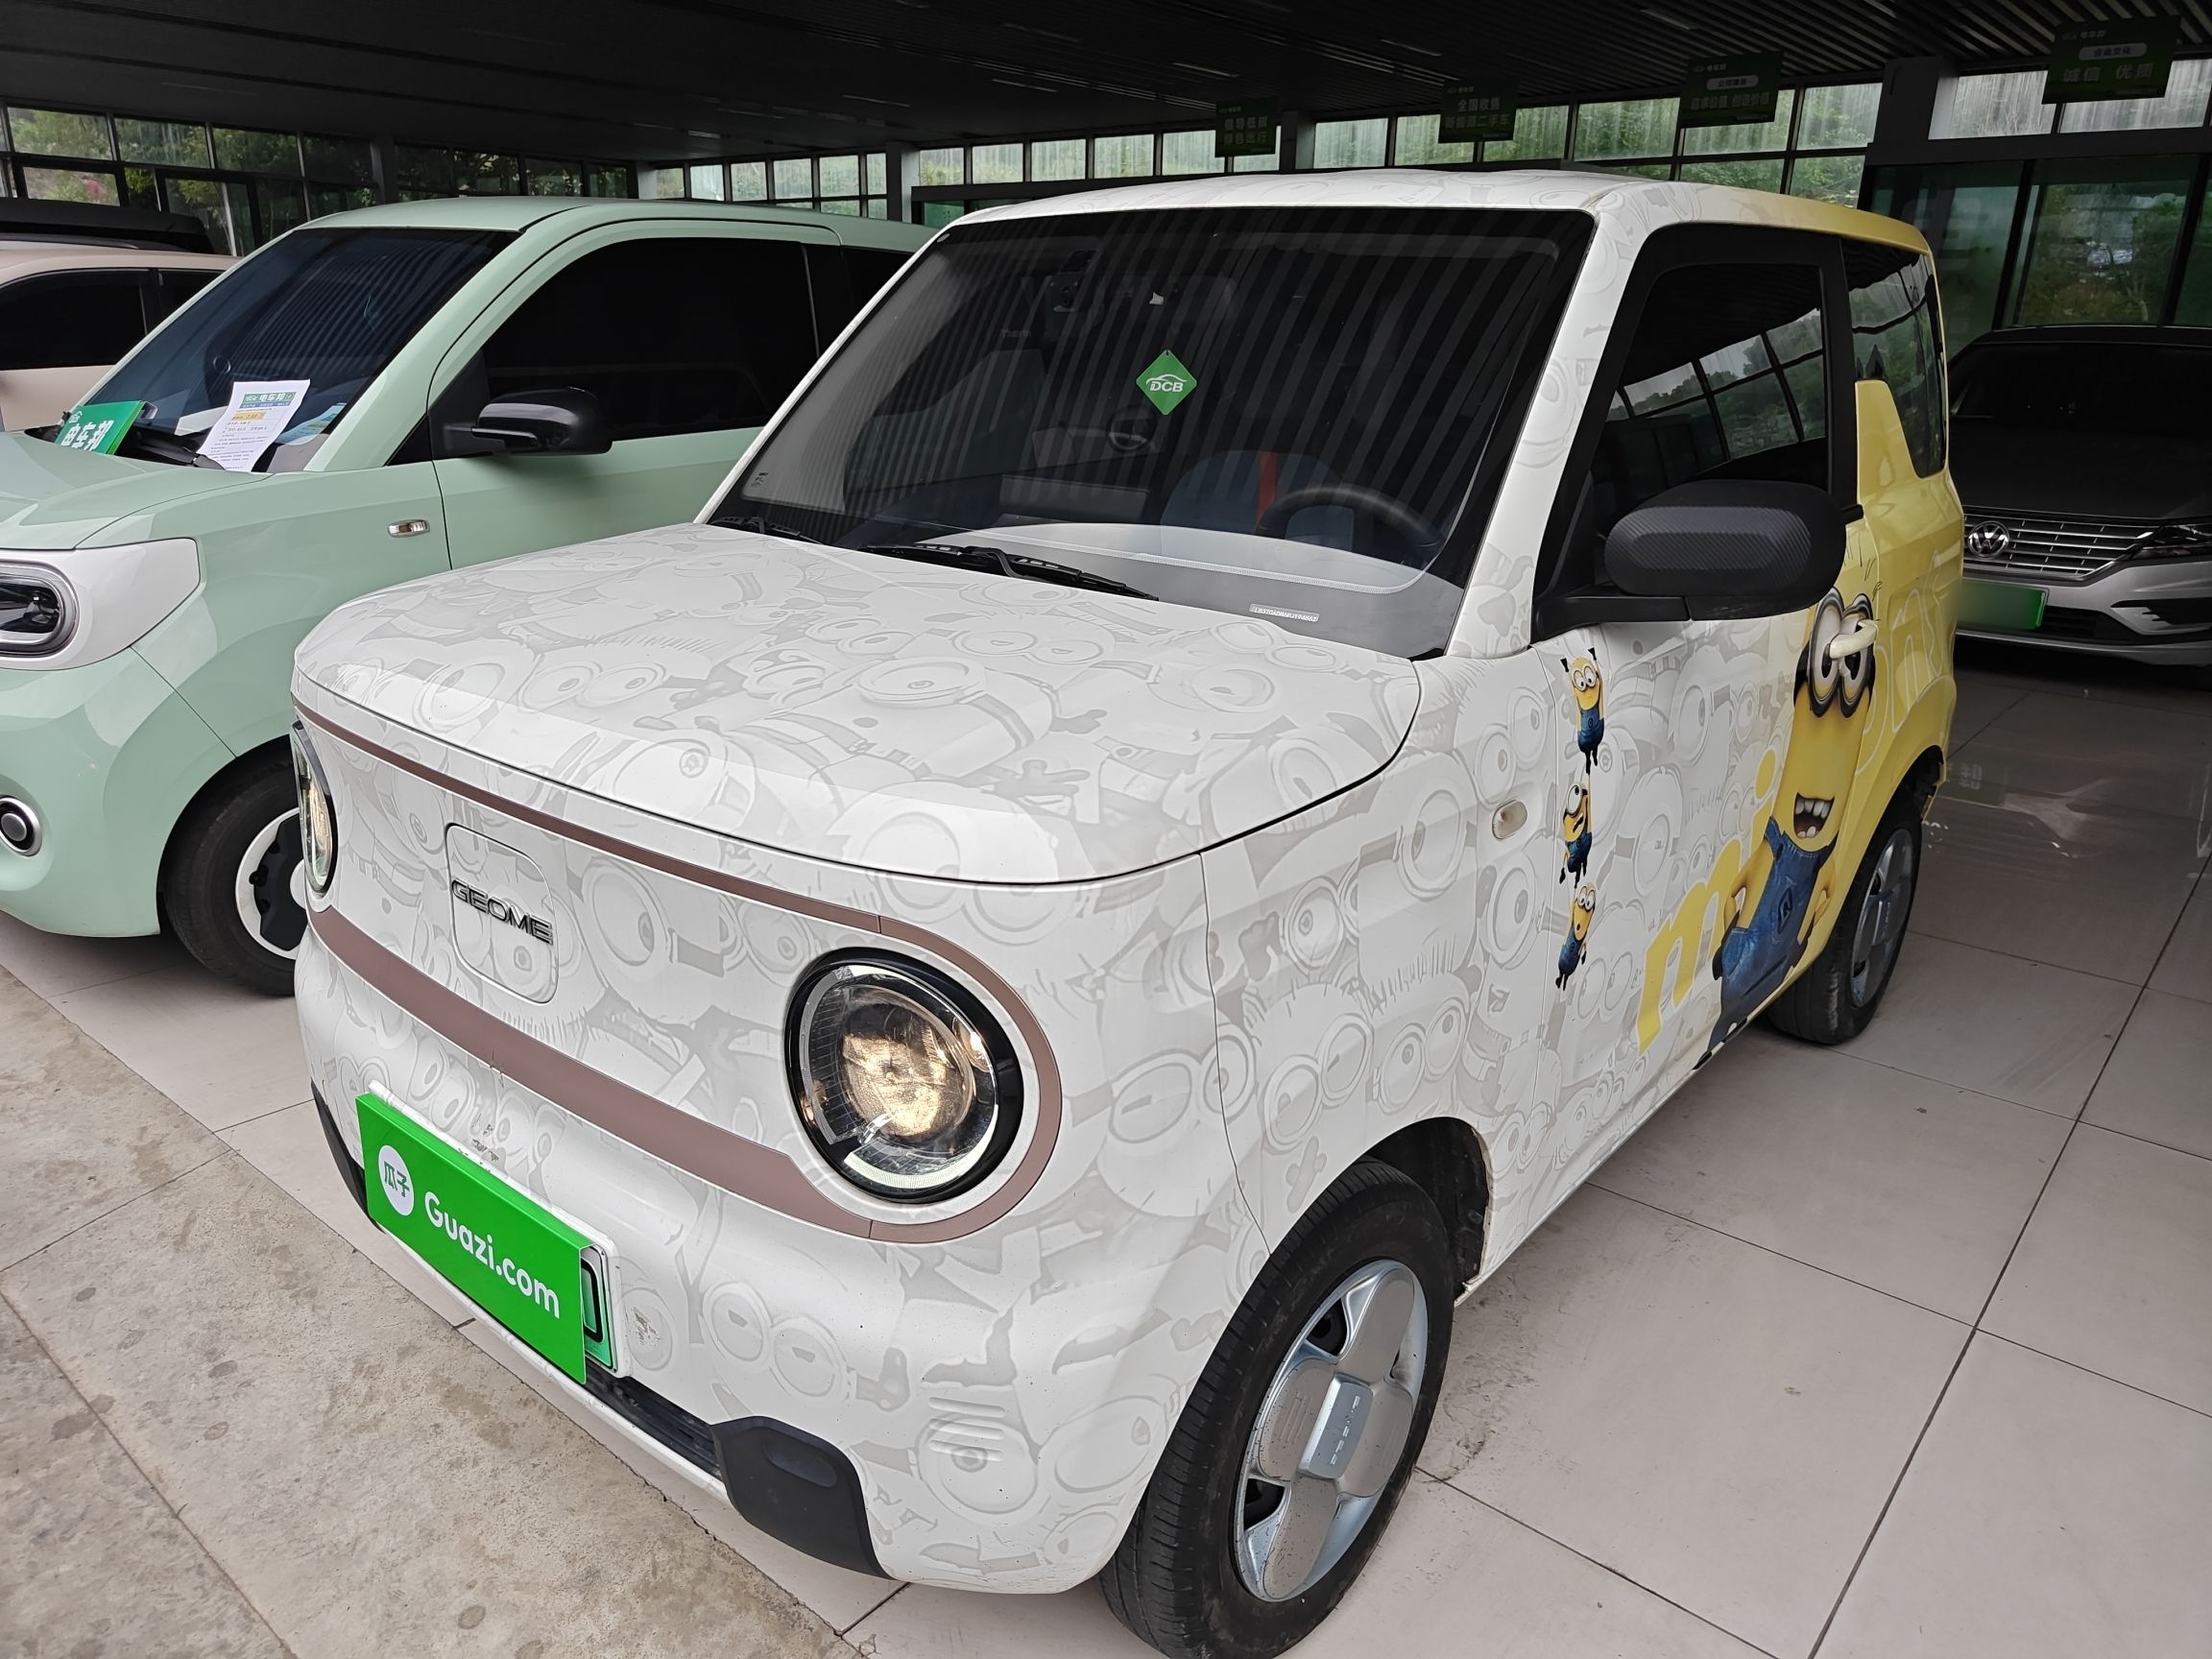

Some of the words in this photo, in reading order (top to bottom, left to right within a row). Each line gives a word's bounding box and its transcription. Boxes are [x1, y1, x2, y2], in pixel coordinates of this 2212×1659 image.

[1149, 380, 1185, 393] DCB
[451, 877, 554, 946] GEOME
[383, 1160, 410, 1198] 瓜子
[423, 1190, 561, 1320] Guazi.com
